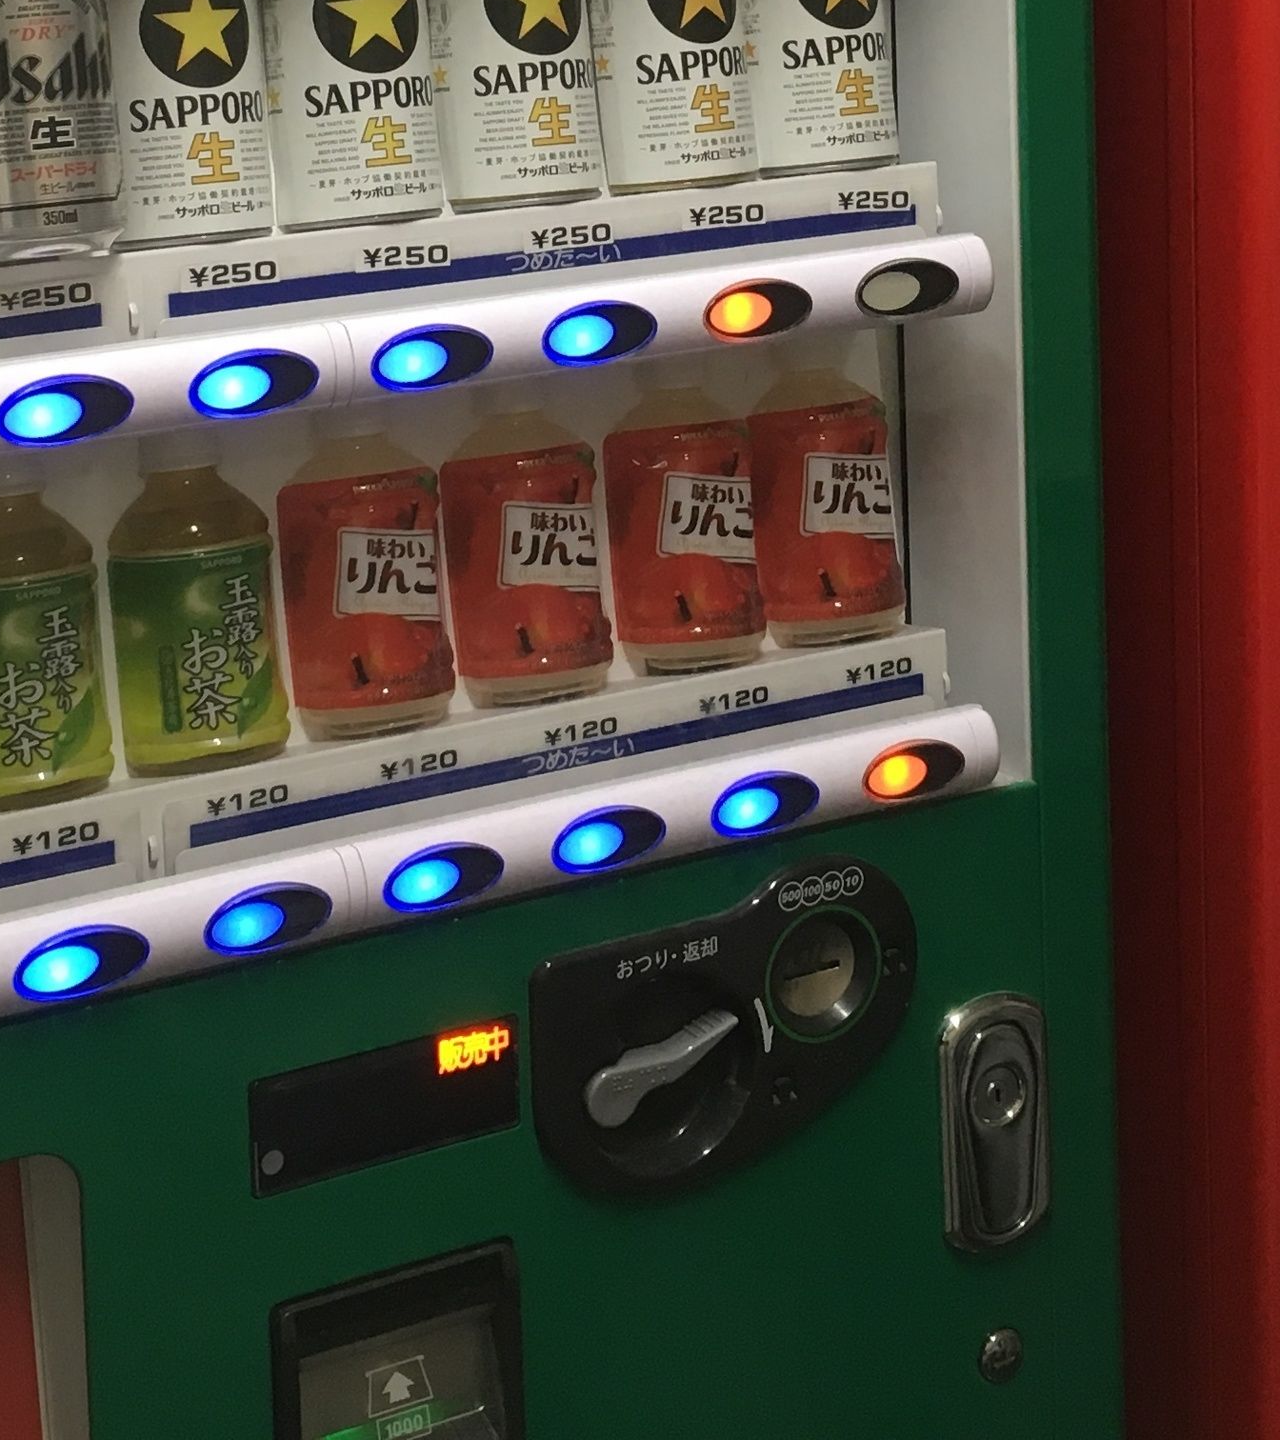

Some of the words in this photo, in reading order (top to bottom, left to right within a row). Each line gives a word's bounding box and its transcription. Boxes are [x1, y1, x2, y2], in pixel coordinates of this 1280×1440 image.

[305, 76, 434, 119] SAPPORO
[835, 68, 879, 117] 生
[129, 90, 264, 132] SAPPORO
[527, 96, 576, 147] 生
[690, 83, 735, 133] 生
[30, 116, 75, 150] 生
[361, 115, 412, 168] 生
[187, 131, 240, 185] 生
[690, 203, 764, 227] ¥250
[838, 190, 909, 212] ¥250
[44, 211, 78, 226] 350ml
[531, 223, 611, 248] ¥250
[364, 244, 448, 269] ¥250
[190, 260, 276, 287] ¥250
[0, 282, 93, 308] ¥250
[181, 626, 240, 732] お茶
[846, 657, 912, 685] ¥120
[699, 686, 768, 714] ¥120
[544, 717, 618, 745] ¥120
[380, 749, 458, 781] ¥120
[207, 785, 289, 815] ¥120
[12, 821, 99, 854] ¥120
[804, 884, 820, 898] 100
[824, 878, 840, 892] 50
[845, 873, 859, 888] 10
[782, 888, 801, 903] 500
[616, 935, 718, 980] おつり・返却
[439, 1026, 509, 1074] 販売中
[385, 1414, 423, 1440] 1000
